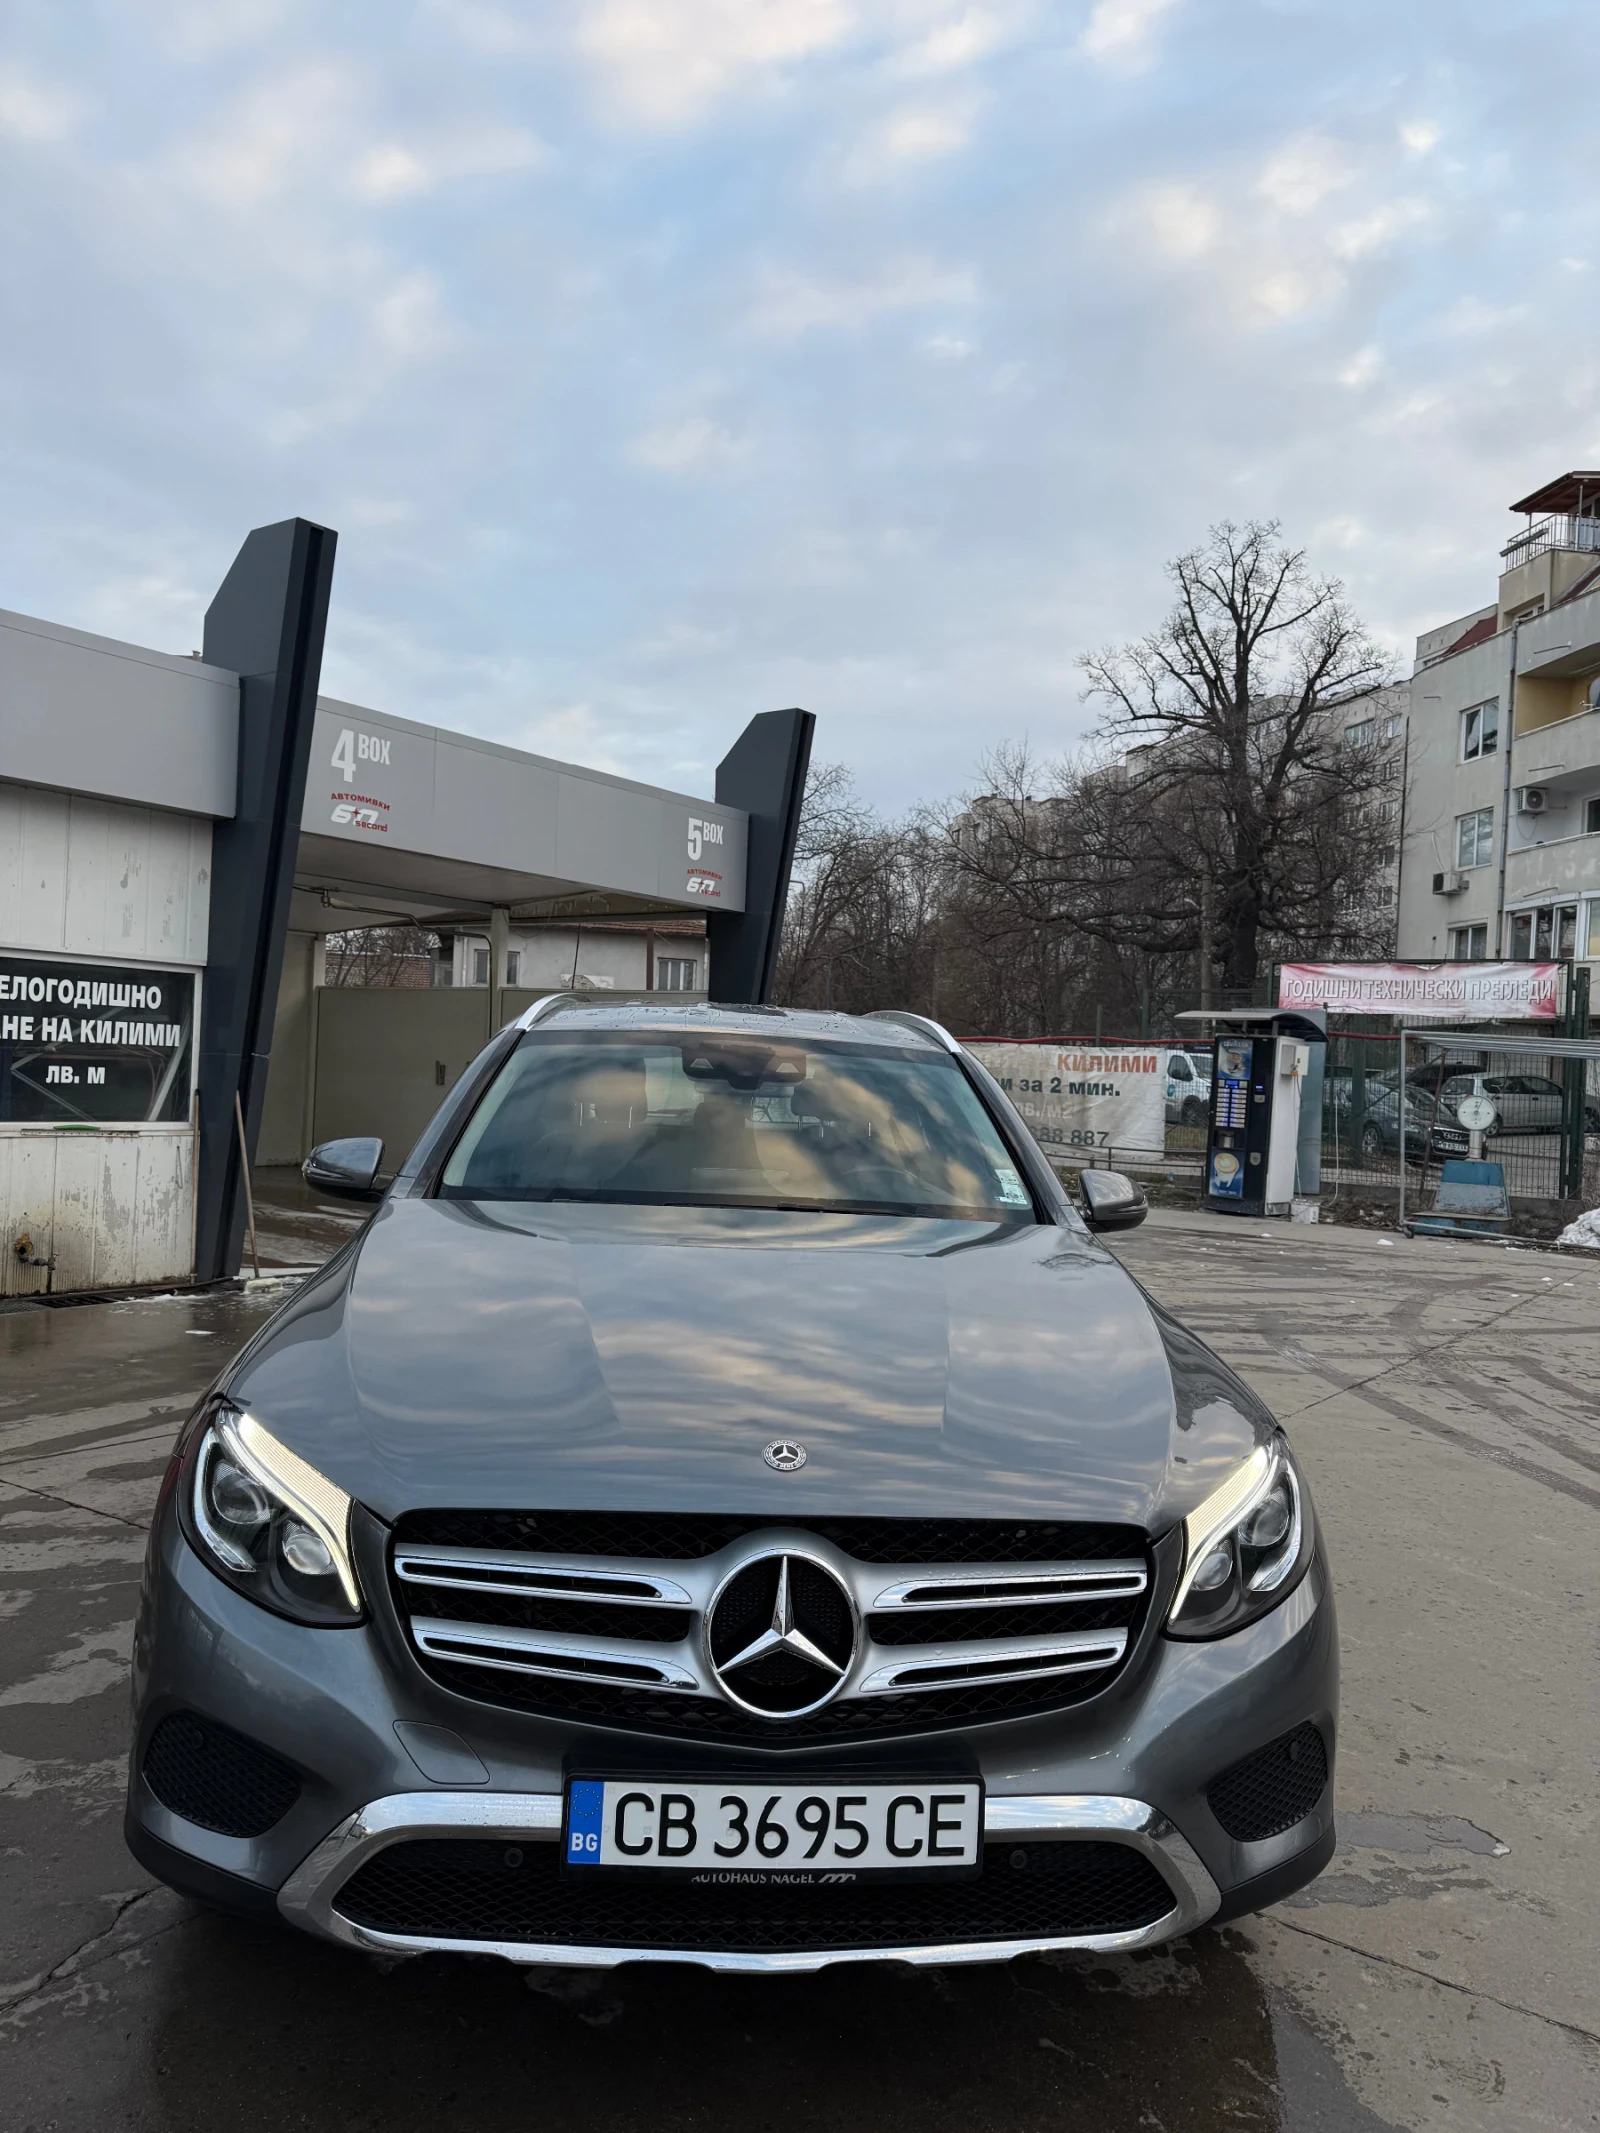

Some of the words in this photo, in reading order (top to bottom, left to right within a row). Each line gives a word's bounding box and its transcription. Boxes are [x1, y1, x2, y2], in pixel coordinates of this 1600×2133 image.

[331, 729, 356, 783] 4
[358, 733, 391, 765] BOX
[330, 793, 390, 811] АВТОМИВКИ
[354, 820, 388, 832] second
[687, 817, 703, 861] 5
[703, 821, 724, 845] BOX
[1284, 979, 1361, 1002] ГОДИШНИ
[1364, 979, 1467, 1001] ТЕХНИЧЕСКИ
[1470, 979, 1553, 1005] ПРЕГЛЕДИ
[0, 1014, 35, 1041] НЕ
[41, 1017, 74, 1043] НА
[80, 1019, 181, 1047] КИЛИМИ
[1057, 1053, 1158, 1074] КИЛИМИ
[995, 1077, 1013, 1091] и
[1019, 1078, 1043, 1093] за
[1050, 1076, 1062, 1094] 2
[1068, 1081, 1121, 1097] мин.
[1070, 1129, 1110, 1147] 887
[571, 1832, 598, 1852] BG
[614, 1792, 697, 1857] CB
[713, 1795, 869, 1859] 3695
[885, 1794, 966, 1858] CE
[691, 1872, 767, 1884] AUTOHAUS
[770, 1873, 815, 1885] NAGEL
